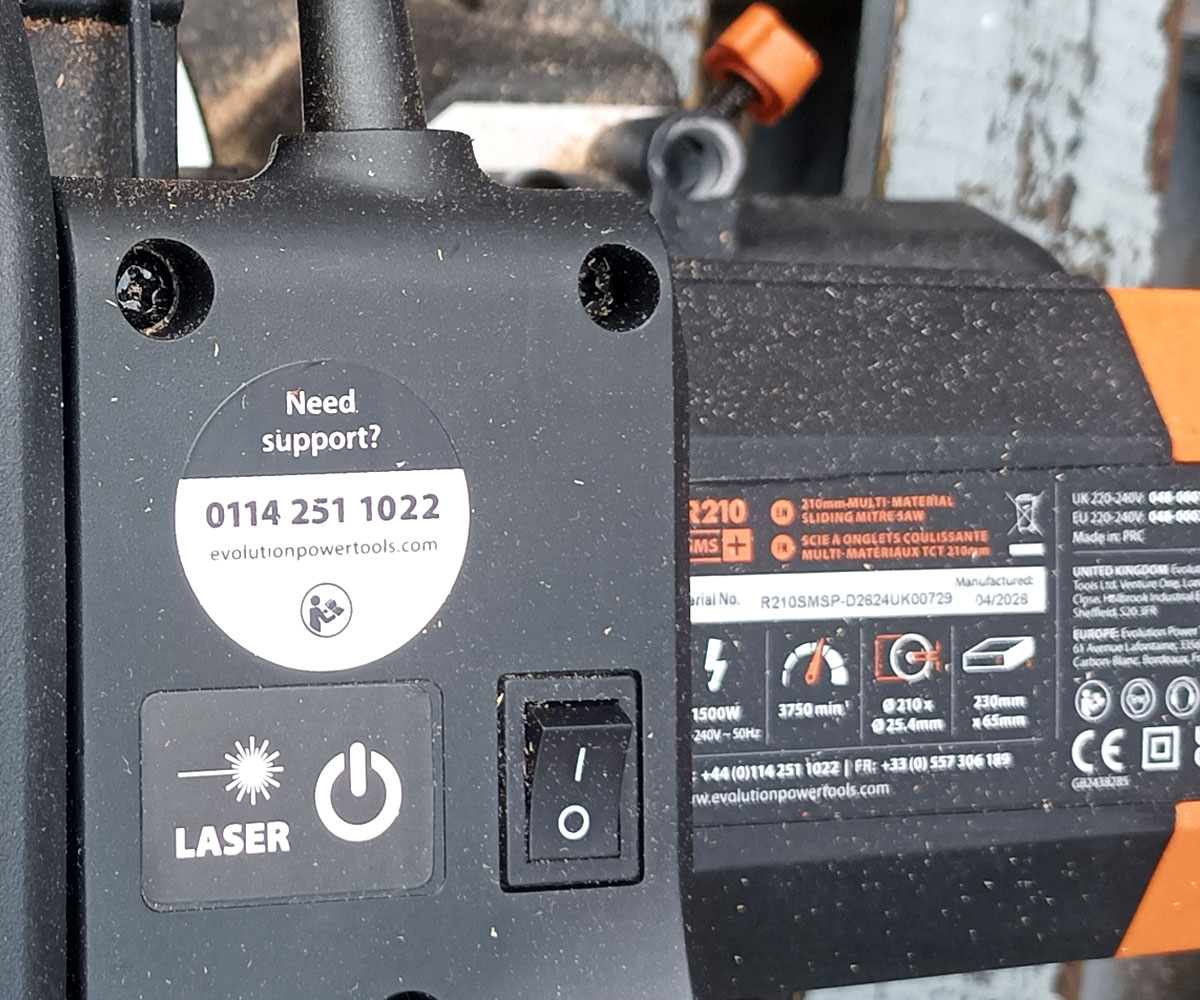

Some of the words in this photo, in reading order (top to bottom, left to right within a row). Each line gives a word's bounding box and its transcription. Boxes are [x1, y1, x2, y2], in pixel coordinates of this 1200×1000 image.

[286, 388, 357, 416] Need
[262, 424, 381, 457] support?
[206, 500, 281, 529] 0114
[291, 497, 346, 525] 251
[360, 493, 441, 522] 1022
[802, 511, 854, 525] SLIDING
[856, 509, 895, 523] MITRE
[896, 509, 927, 523] SAW
[802, 534, 831, 547] SCIE
[843, 531, 902, 546] ONGLETS
[903, 529, 989, 545] COULISSANTE
[1072, 530, 1105, 546] Made
[1122, 528, 1146, 544] PRC
[210, 538, 438, 561] evolutionpowertools.com
[921, 544, 945, 558] TCT
[1072, 566, 1113, 578] UNITED
[1114, 564, 1169, 577] KINGDOM
[954, 574, 1034, 588] Manufactured:
[719, 591, 741, 606] No.
[777, 702, 815, 719] 3750
[973, 694, 1028, 711] 230mm
[691, 705, 743, 723] 1500W
[733, 725, 764, 742] 50Hz
[1071, 728, 1127, 774] CE
[700, 765, 731, 783] +44
[731, 763, 776, 782] (0)114
[776, 762, 802, 779] 251
[805, 760, 841, 778] 1022
[854, 758, 878, 776] FR:
[881, 757, 909, 775] +33
[909, 756, 928, 775] (0)
[929, 755, 956, 773] 557
[956, 754, 985, 772] 306
[175, 820, 291, 859] LASER
